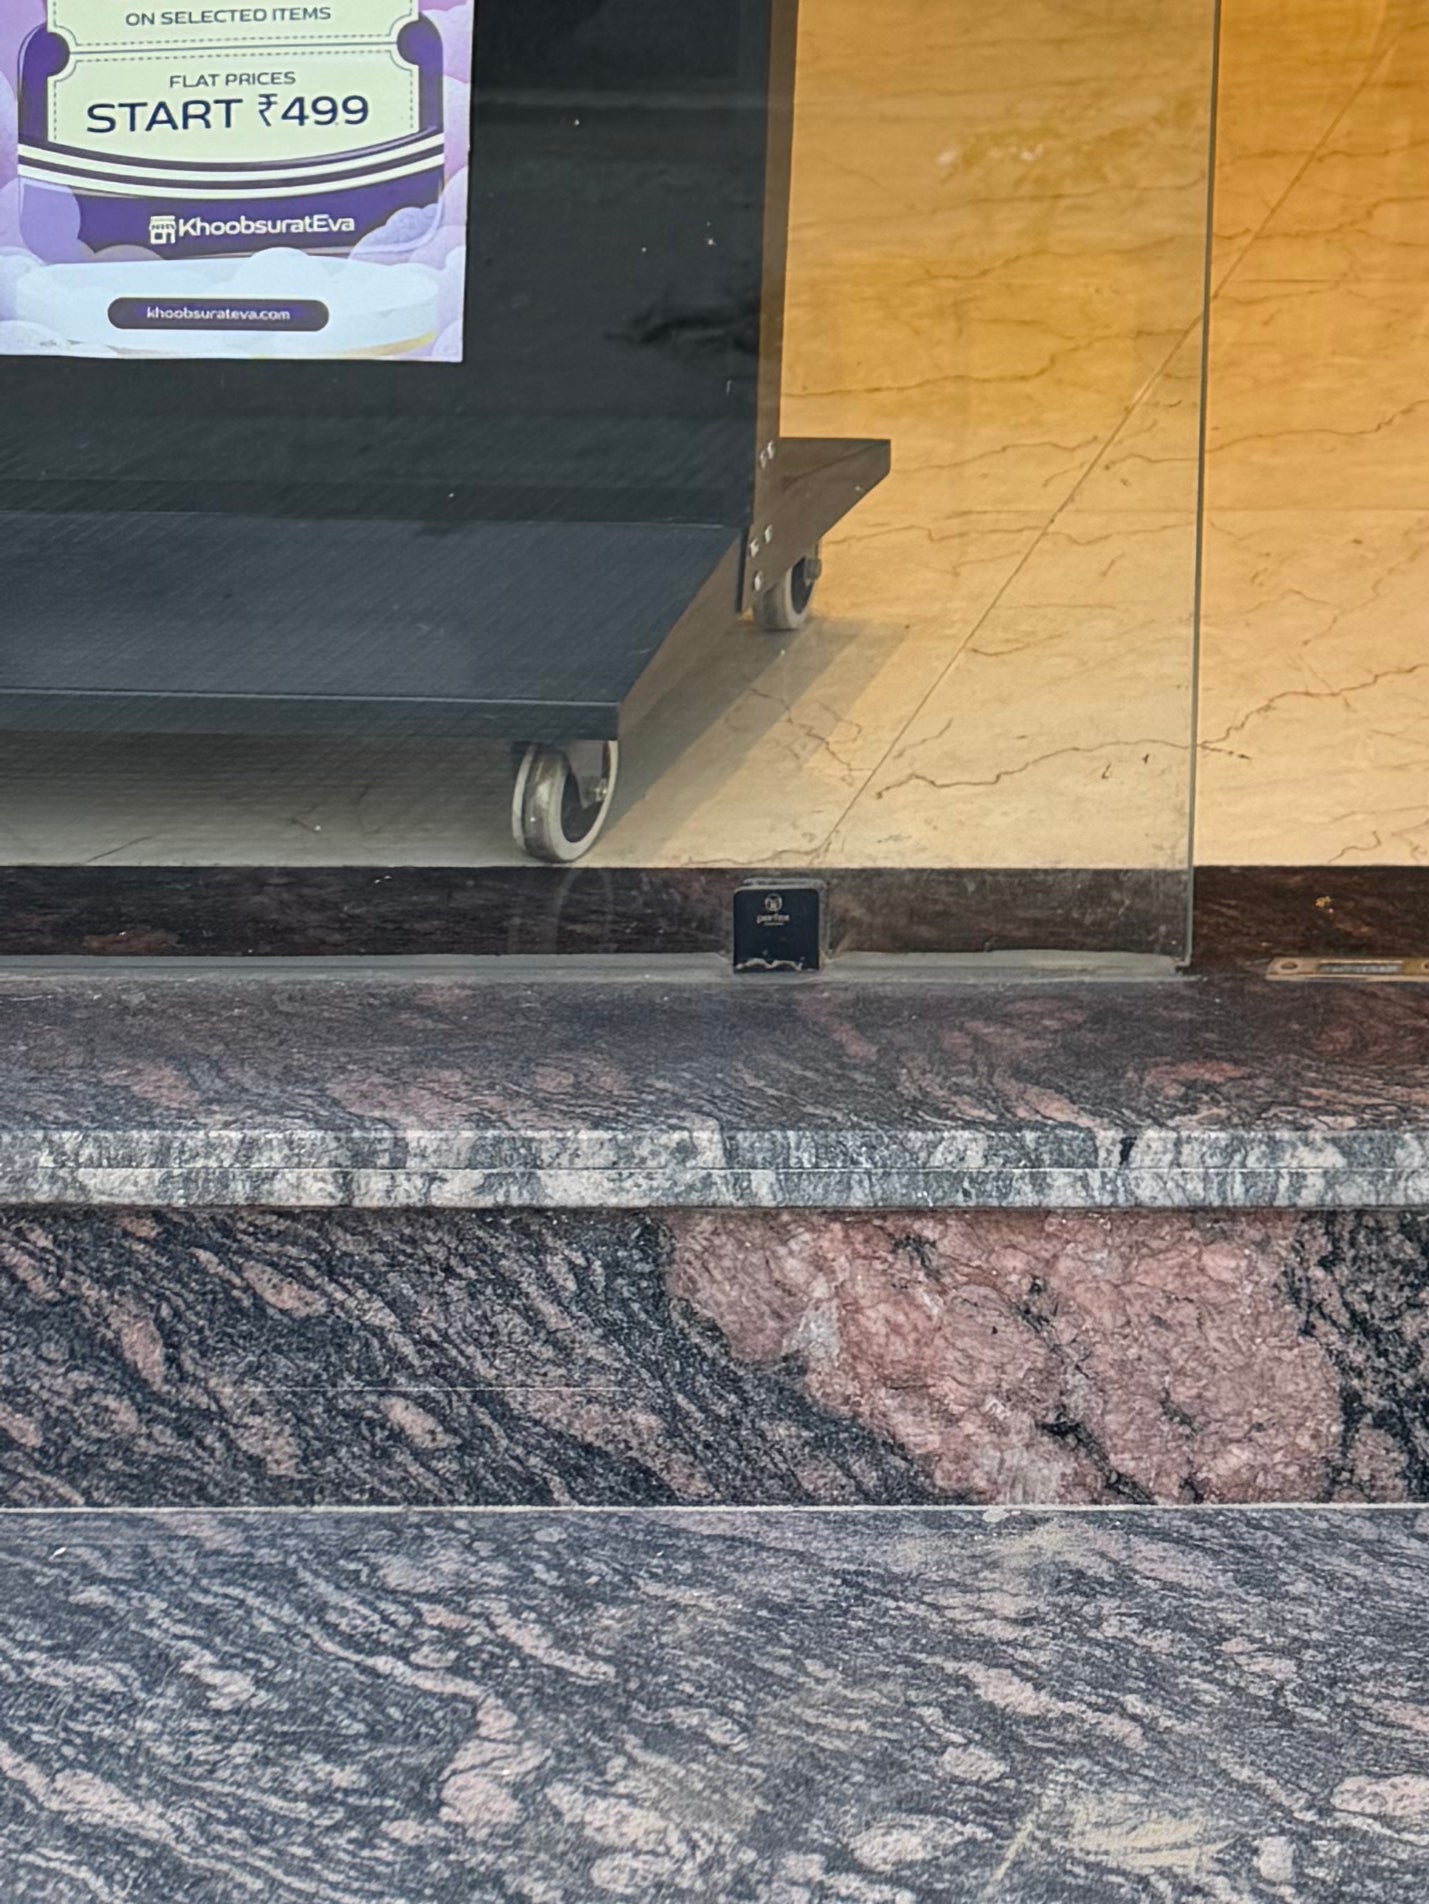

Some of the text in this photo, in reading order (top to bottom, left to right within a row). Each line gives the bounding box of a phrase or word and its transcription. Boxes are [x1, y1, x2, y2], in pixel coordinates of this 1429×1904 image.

[125, 6, 332, 27] ON SELECTED ITEMS
[169, 70, 297, 89] FLAT PRICES
[86, 93, 370, 134] START ₹499
[179, 213, 356, 237] KhoobsuratEva
[146, 306, 292, 323] khoobsurateva.com
